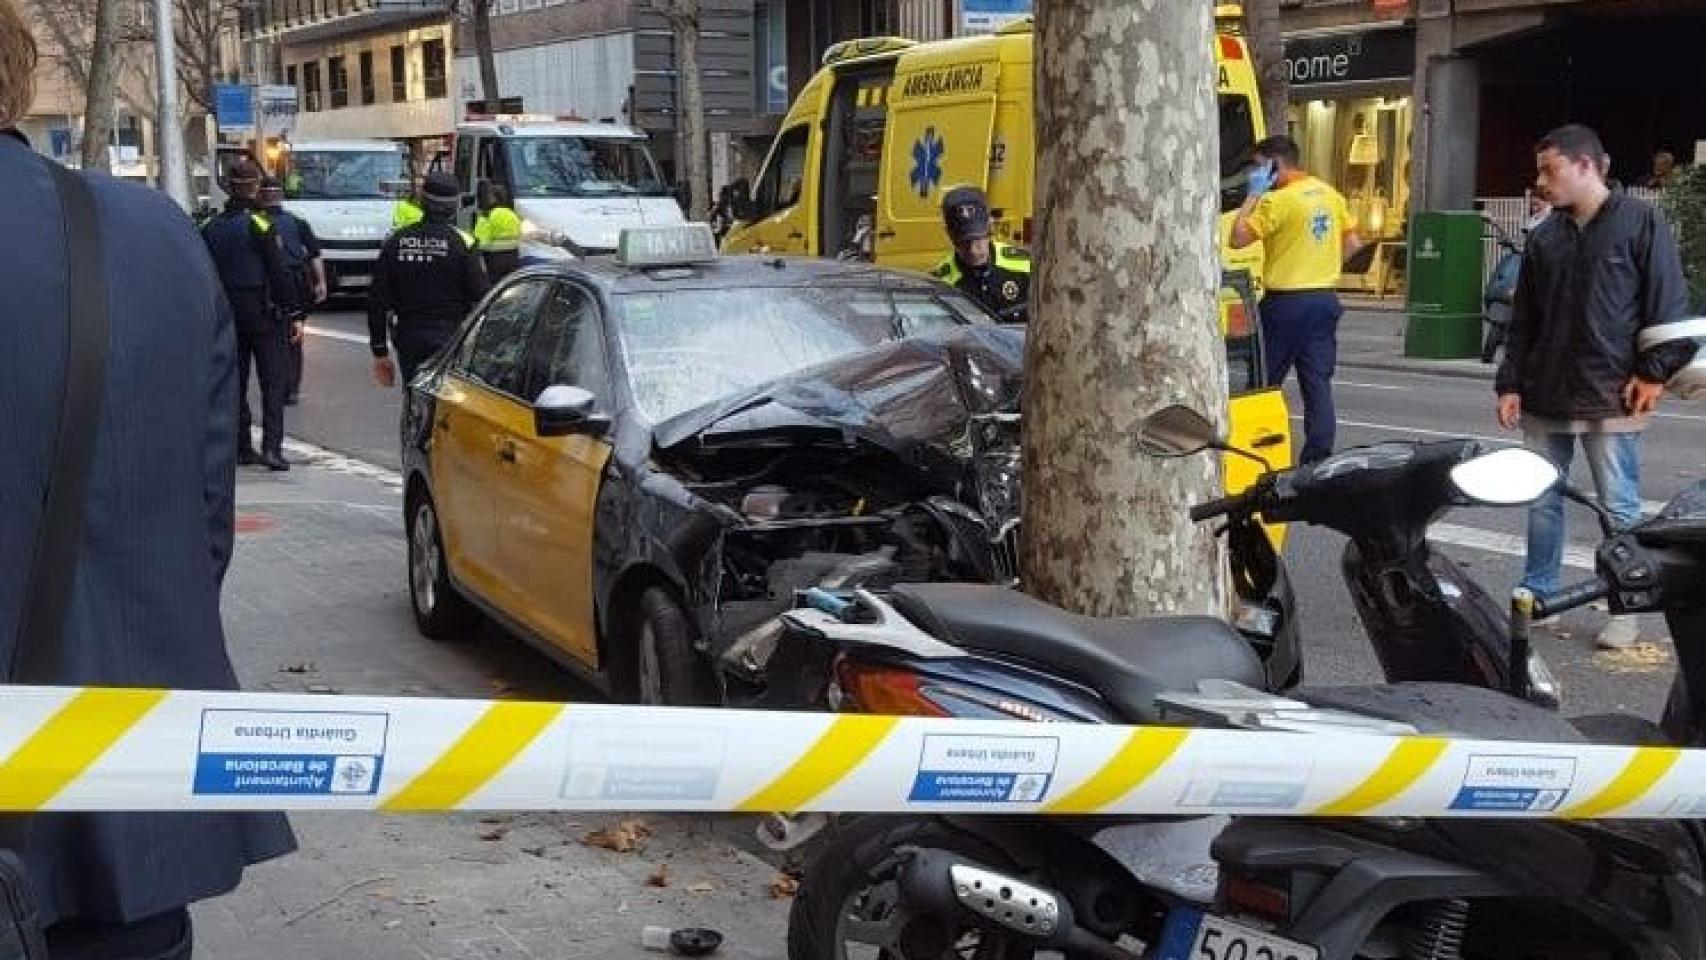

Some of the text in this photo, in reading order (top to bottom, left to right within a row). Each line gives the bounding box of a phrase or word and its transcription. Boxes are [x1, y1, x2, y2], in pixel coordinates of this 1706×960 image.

[234, 726, 291, 740] Urbana
[225, 759, 328, 773] de Barcelona
[1200, 929, 1299, 960] 50
